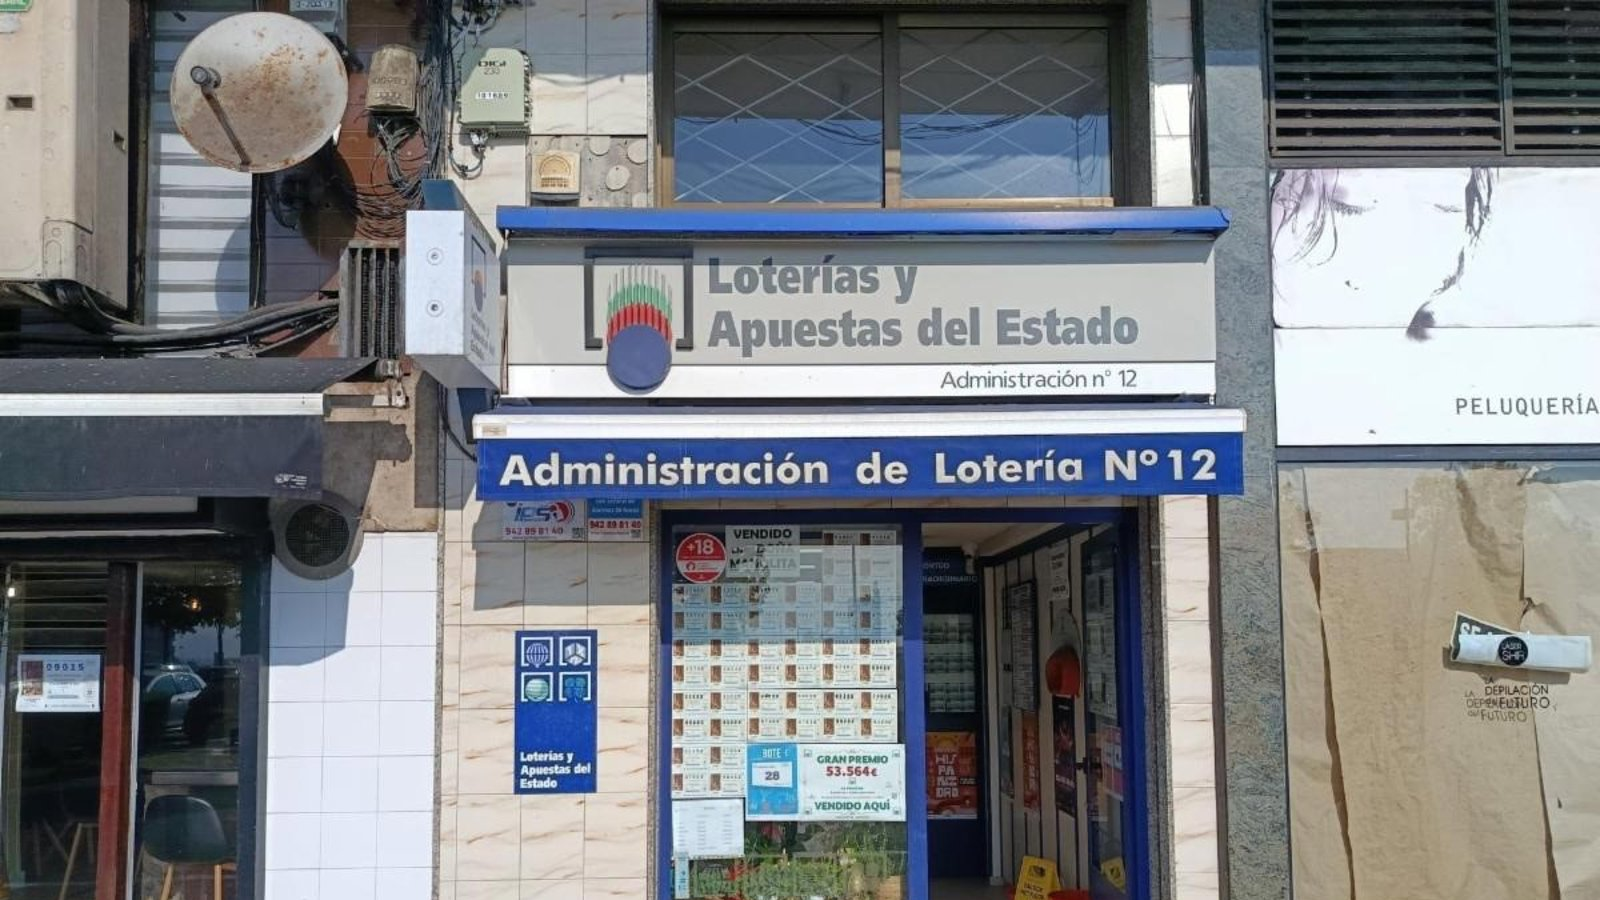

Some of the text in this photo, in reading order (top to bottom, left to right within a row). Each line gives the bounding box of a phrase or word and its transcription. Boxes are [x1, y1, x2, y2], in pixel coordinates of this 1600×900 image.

[708, 254, 918, 304] Loterías y
[707, 306, 1139, 358] Apuestas del Estado
[940, 370, 1087, 389] Administración
[1118, 370, 1137, 387] 12
[1455, 393, 1600, 417] PELUQUERÍA
[499, 452, 829, 487] Administración
[855, 451, 909, 485] de
[934, 450, 1083, 484] Lotería
[1168, 449, 1217, 481] 12
[733, 528, 793, 540] VENDIDO
[686, 539, 714, 555] +18
[1485, 682, 1549, 696] DEPILACIÓN
[1500, 697, 1551, 709] FUTURO
[520, 750, 574, 763] Loterías y
[817, 755, 888, 764] GRAN PREMIO
[520, 762, 591, 777] Apuestas del
[765, 770, 780, 781] 28
[520, 777, 558, 789] Estado
[815, 799, 890, 810] VENDIDO AQUÍ
